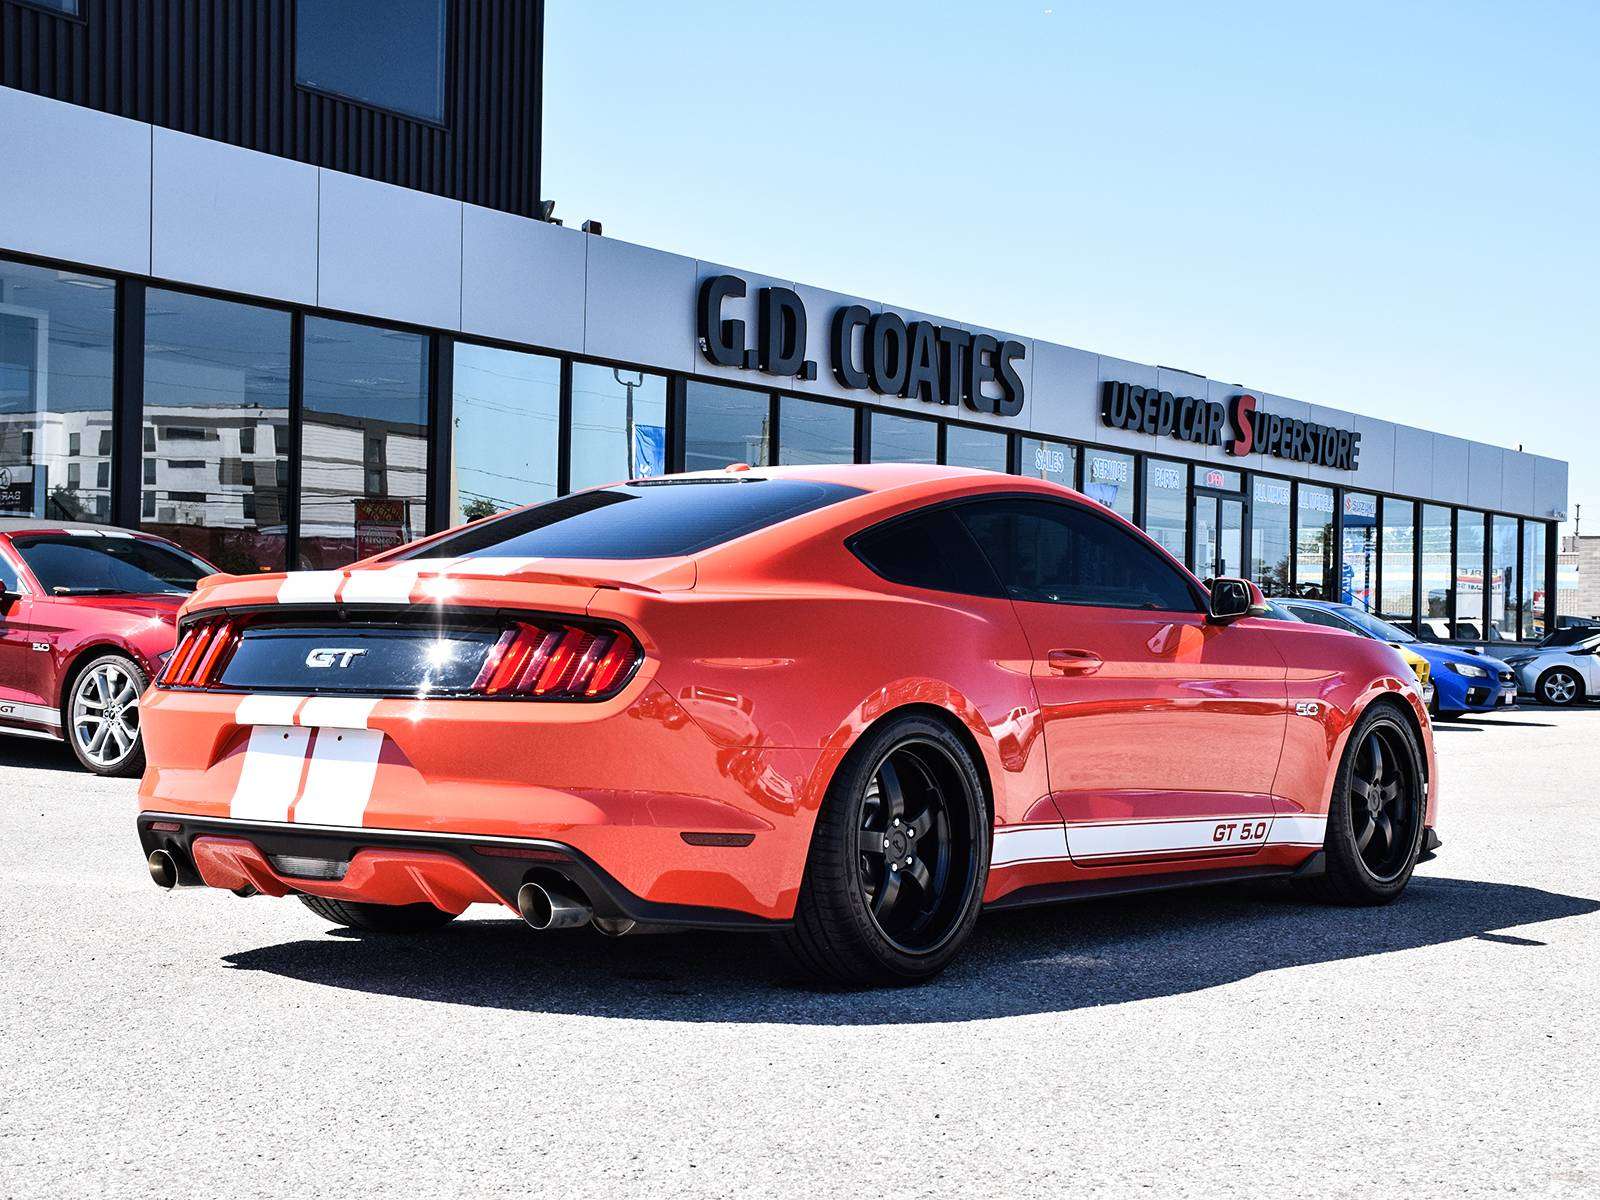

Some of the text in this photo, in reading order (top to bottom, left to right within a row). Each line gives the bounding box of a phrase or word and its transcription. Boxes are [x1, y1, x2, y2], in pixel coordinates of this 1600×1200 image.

[699, 275, 1025, 417] G.D. COATES
[1102, 381, 1361, 471] USED CAR SUPERSTORE
[1035, 448, 1064, 473] SALES
[1092, 457, 1128, 482] SERVICE
[1154, 467, 1180, 489] PARTS
[1207, 471, 1225, 488] OPEN
[1352, 498, 1376, 514] SUZUKI
[305, 647, 368, 668] GT
[0, 705, 15, 714] GT
[1213, 822, 1266, 842] GT 5.0
